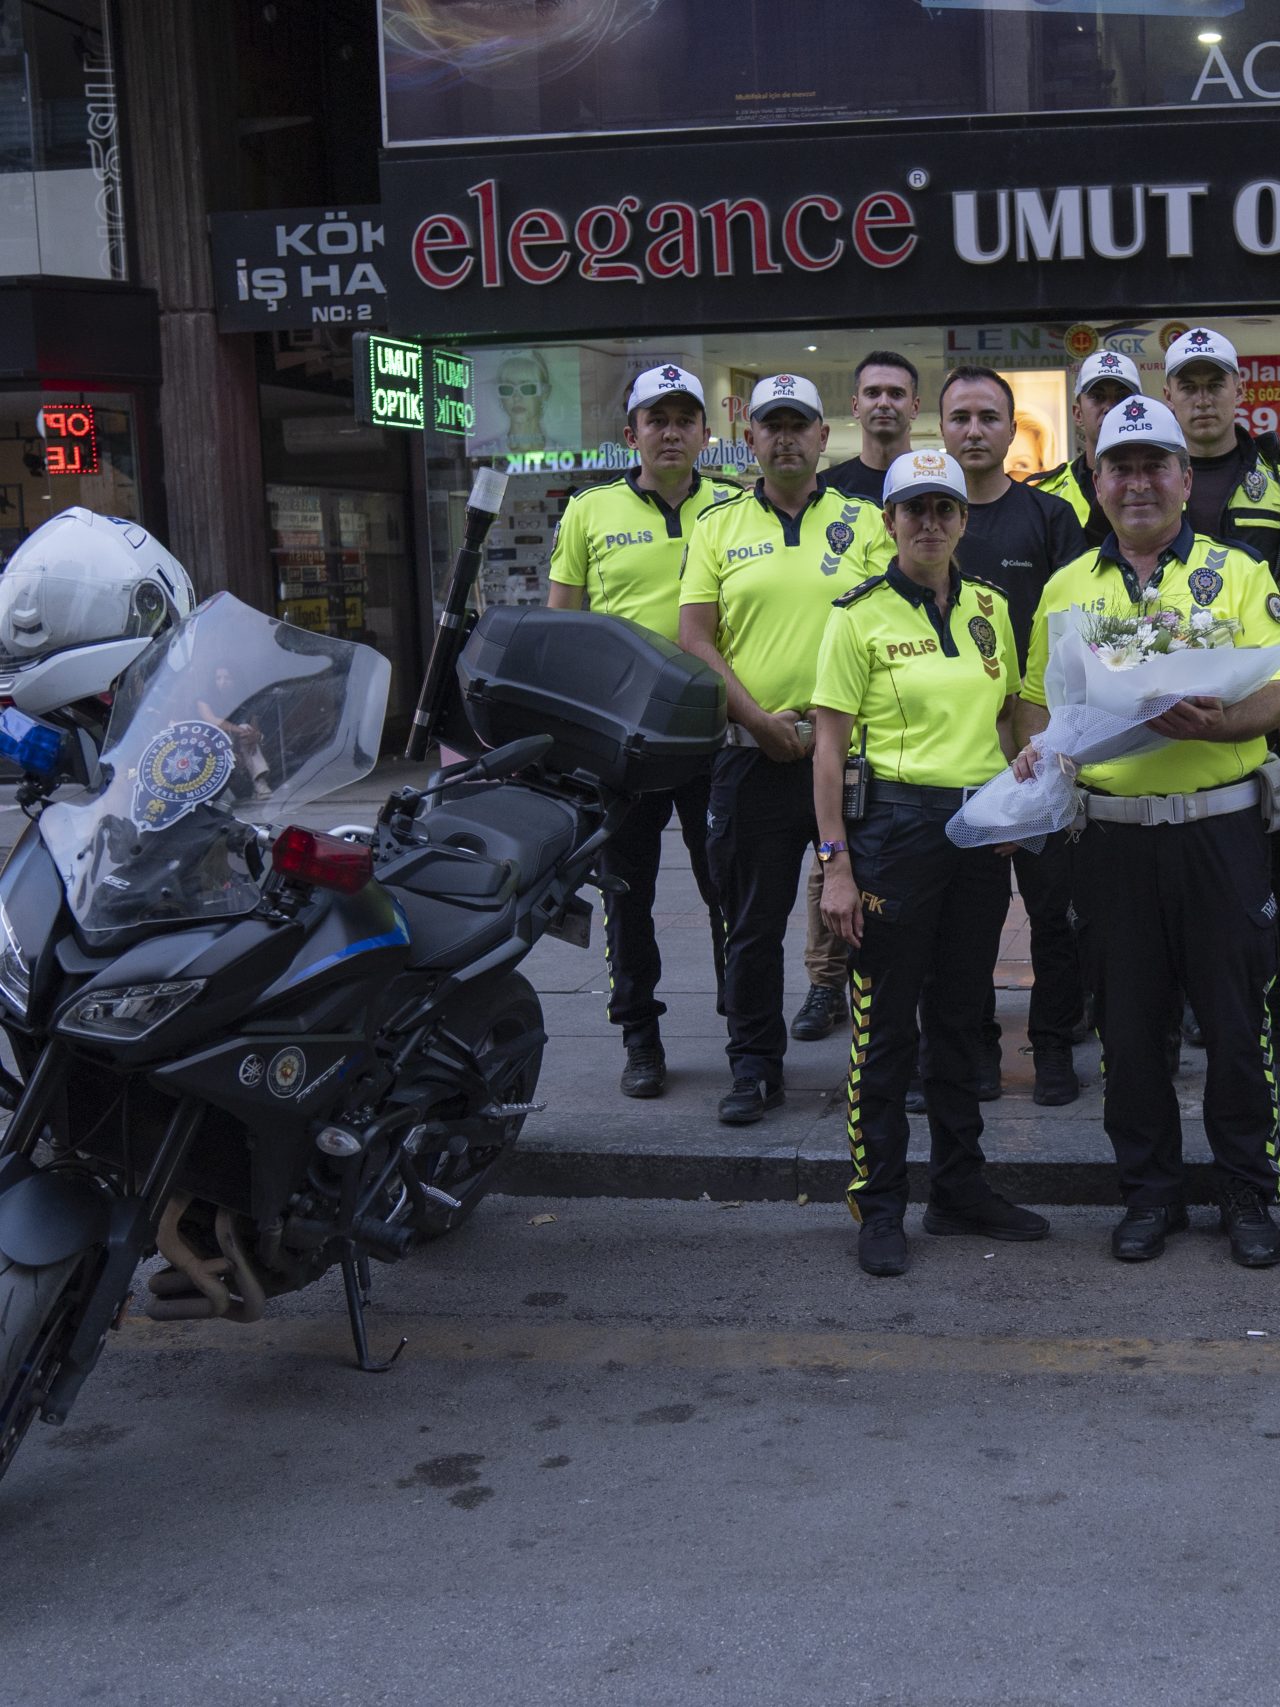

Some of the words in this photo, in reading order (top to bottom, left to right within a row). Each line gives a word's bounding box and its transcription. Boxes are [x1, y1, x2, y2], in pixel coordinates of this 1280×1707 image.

[411, 178, 918, 290] elegance
[953, 184, 1208, 265] UMUT
[376, 345, 419, 379] UMUT
